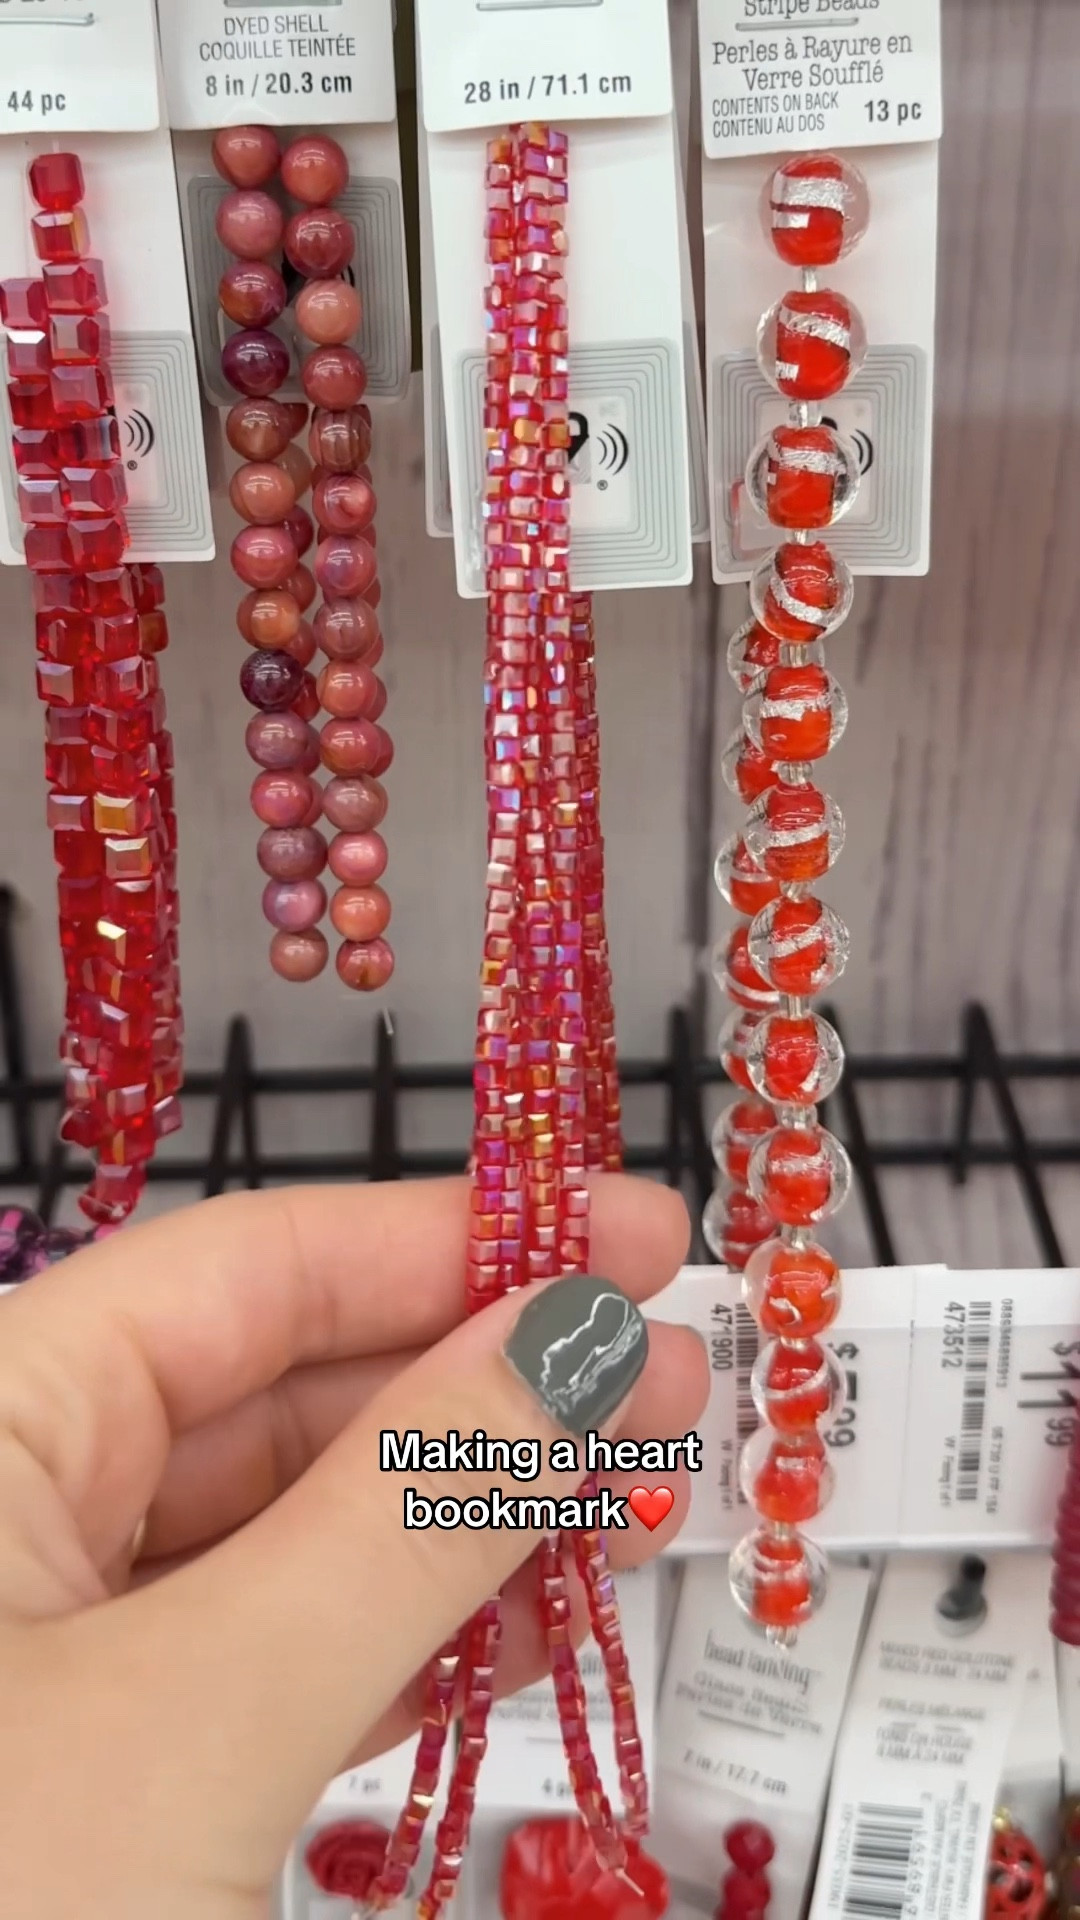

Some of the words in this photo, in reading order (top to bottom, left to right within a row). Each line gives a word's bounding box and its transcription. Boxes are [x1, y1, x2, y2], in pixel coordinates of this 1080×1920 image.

[743, 0, 810, 19] Stripe
[223, 16, 269, 36] DYED
[274, 14, 329, 34] SHELL
[199, 40, 283, 61] COQUILLE
[288, 33, 356, 57] TEINTÉE
[712, 40, 778, 65] Perles
[784, 37, 798, 61] à
[802, 36, 881, 63] Rayure
[887, 34, 913, 53] en
[205, 75, 218, 97] 8
[225, 74, 245, 96] in
[251, 73, 260, 98] /
[265, 71, 314, 94] 20.3
[321, 74, 352, 93] cm
[464, 81, 491, 104] 28
[500, 79, 520, 100] in
[527, 75, 536, 100] /
[541, 72, 588, 97] 71.1
[599, 74, 632, 94] cm
[742, 68, 803, 91] Verre
[809, 59, 884, 87] Soufflé
[7, 89, 34, 112] 44
[41, 93, 66, 116] pc
[712, 95, 779, 117] CONTENTS
[783, 94, 801, 112] ON
[805, 91, 839, 110] BACK
[864, 99, 889, 122] 13
[897, 101, 922, 126] pc
[712, 117, 773, 138] CONTENU
[776, 115, 794, 133] AU
[798, 113, 825, 132] DOS
[710, 1303, 733, 1370] 471900
[941, 1301, 966, 1368] 473512
